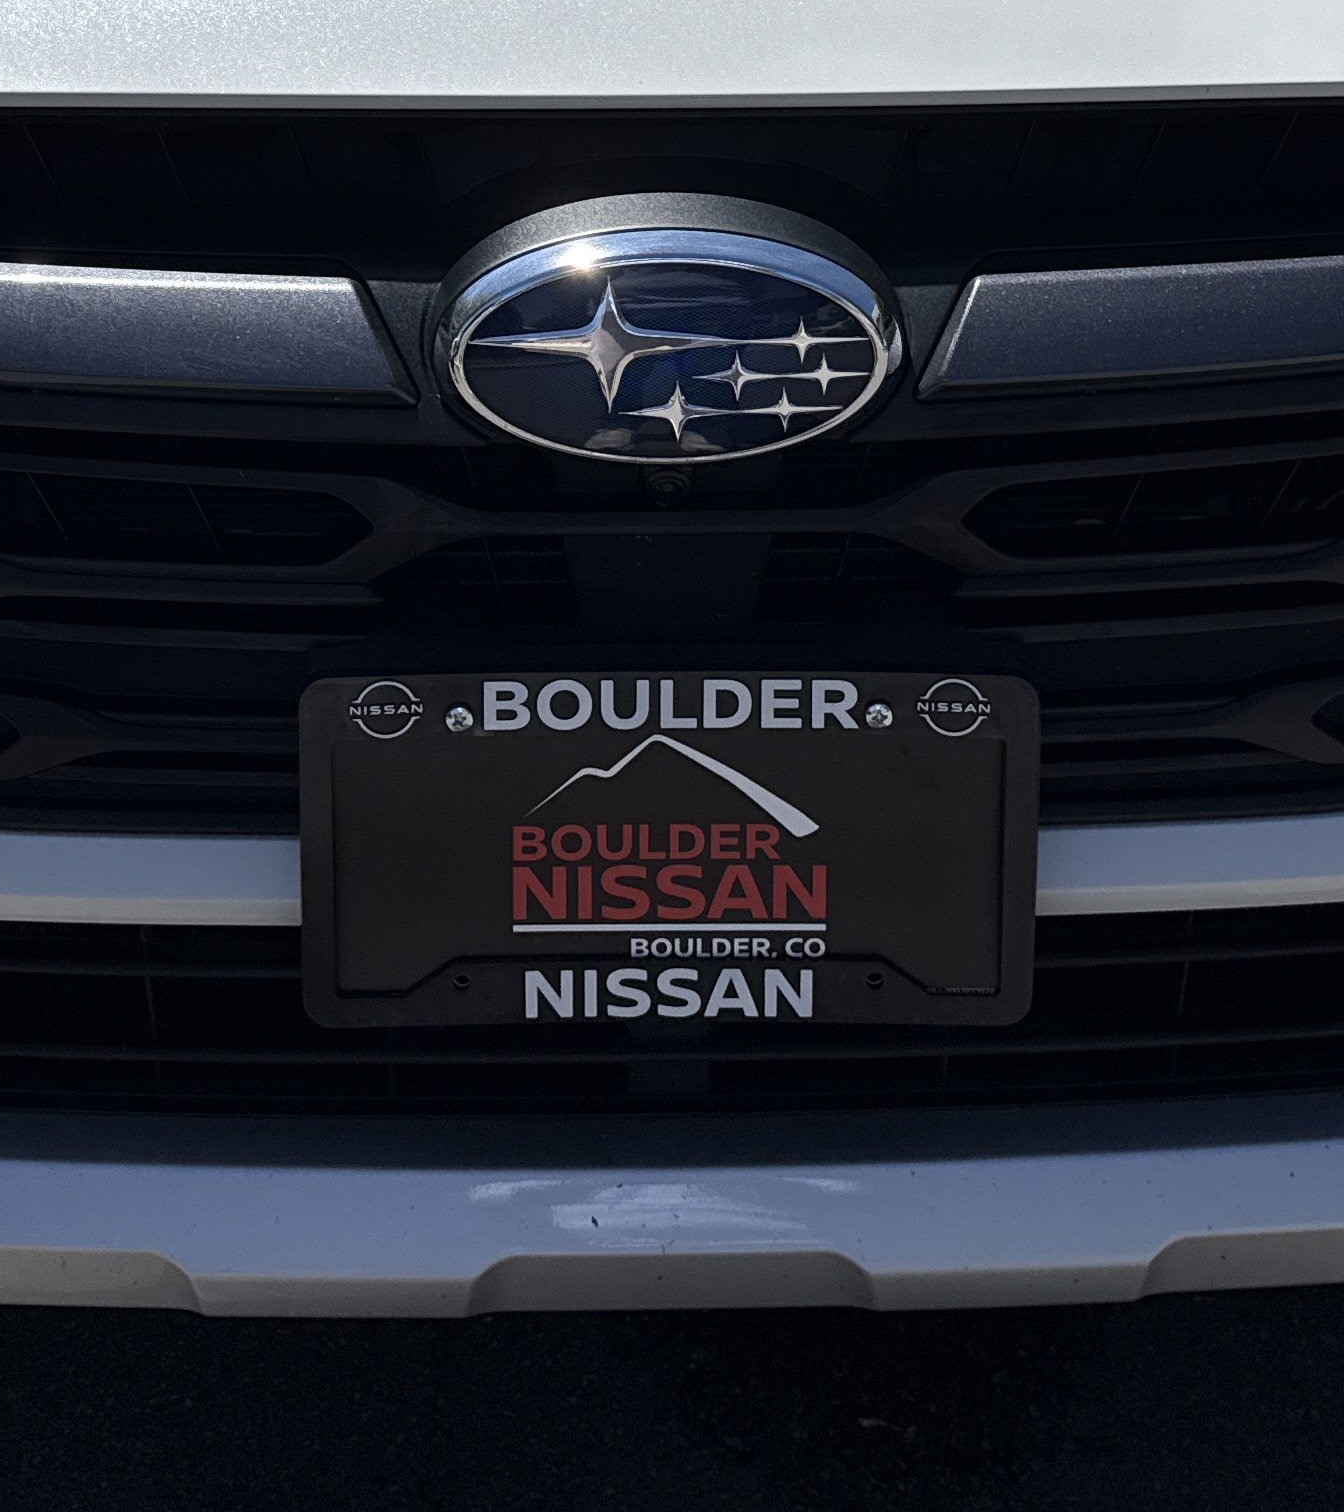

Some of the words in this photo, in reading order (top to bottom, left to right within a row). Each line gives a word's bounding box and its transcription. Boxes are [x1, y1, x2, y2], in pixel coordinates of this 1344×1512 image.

[349, 702, 424, 718] NISSAN
[482, 679, 860, 731] BOULDER
[916, 700, 992, 715] NISSAN
[512, 823, 781, 861] BOULDER
[512, 864, 827, 921] NISSAN
[630, 937, 777, 958] BOULDER,
[784, 937, 826, 958] CO
[524, 967, 814, 1019] NISSAN
